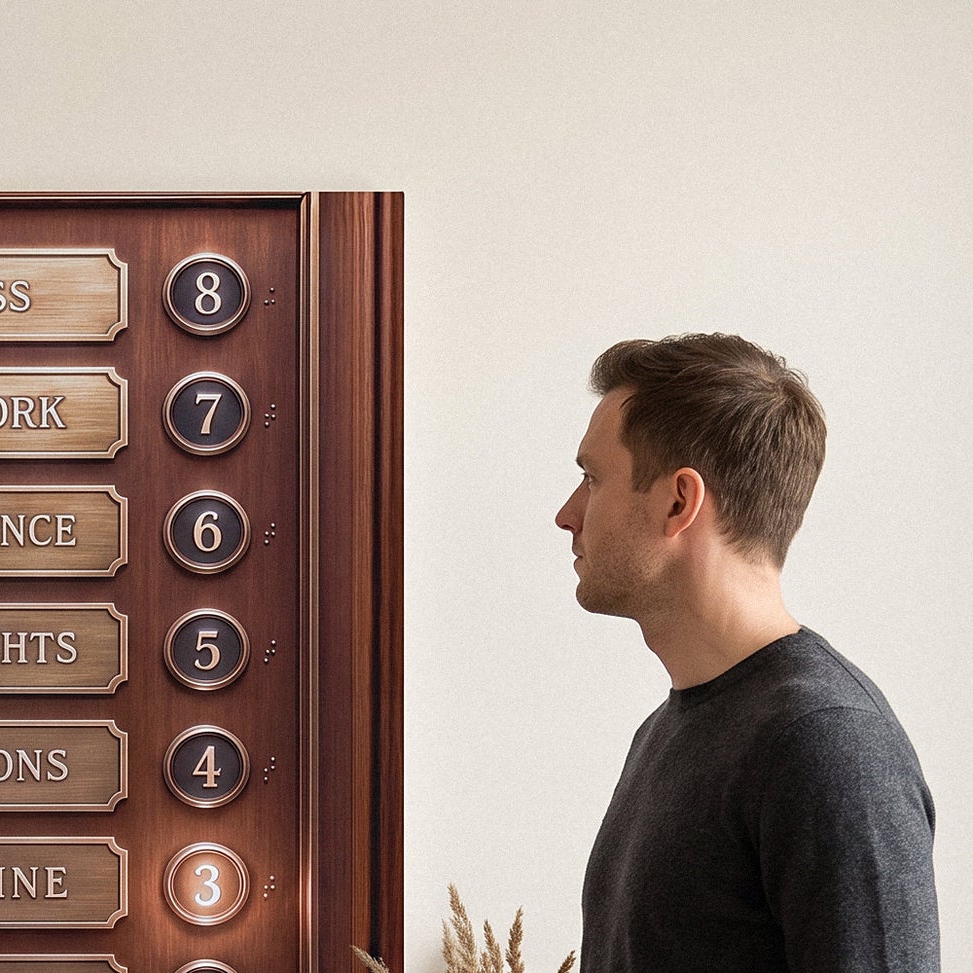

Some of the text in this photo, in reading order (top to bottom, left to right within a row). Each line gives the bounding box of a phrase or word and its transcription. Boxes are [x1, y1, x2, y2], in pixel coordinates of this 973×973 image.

[194, 272, 221, 316] 8
[195, 392, 223, 435] 7
[193, 511, 221, 553] 6
[194, 630, 220, 671] 5
[192, 746, 222, 788] 4
[193, 864, 221, 907] 3
